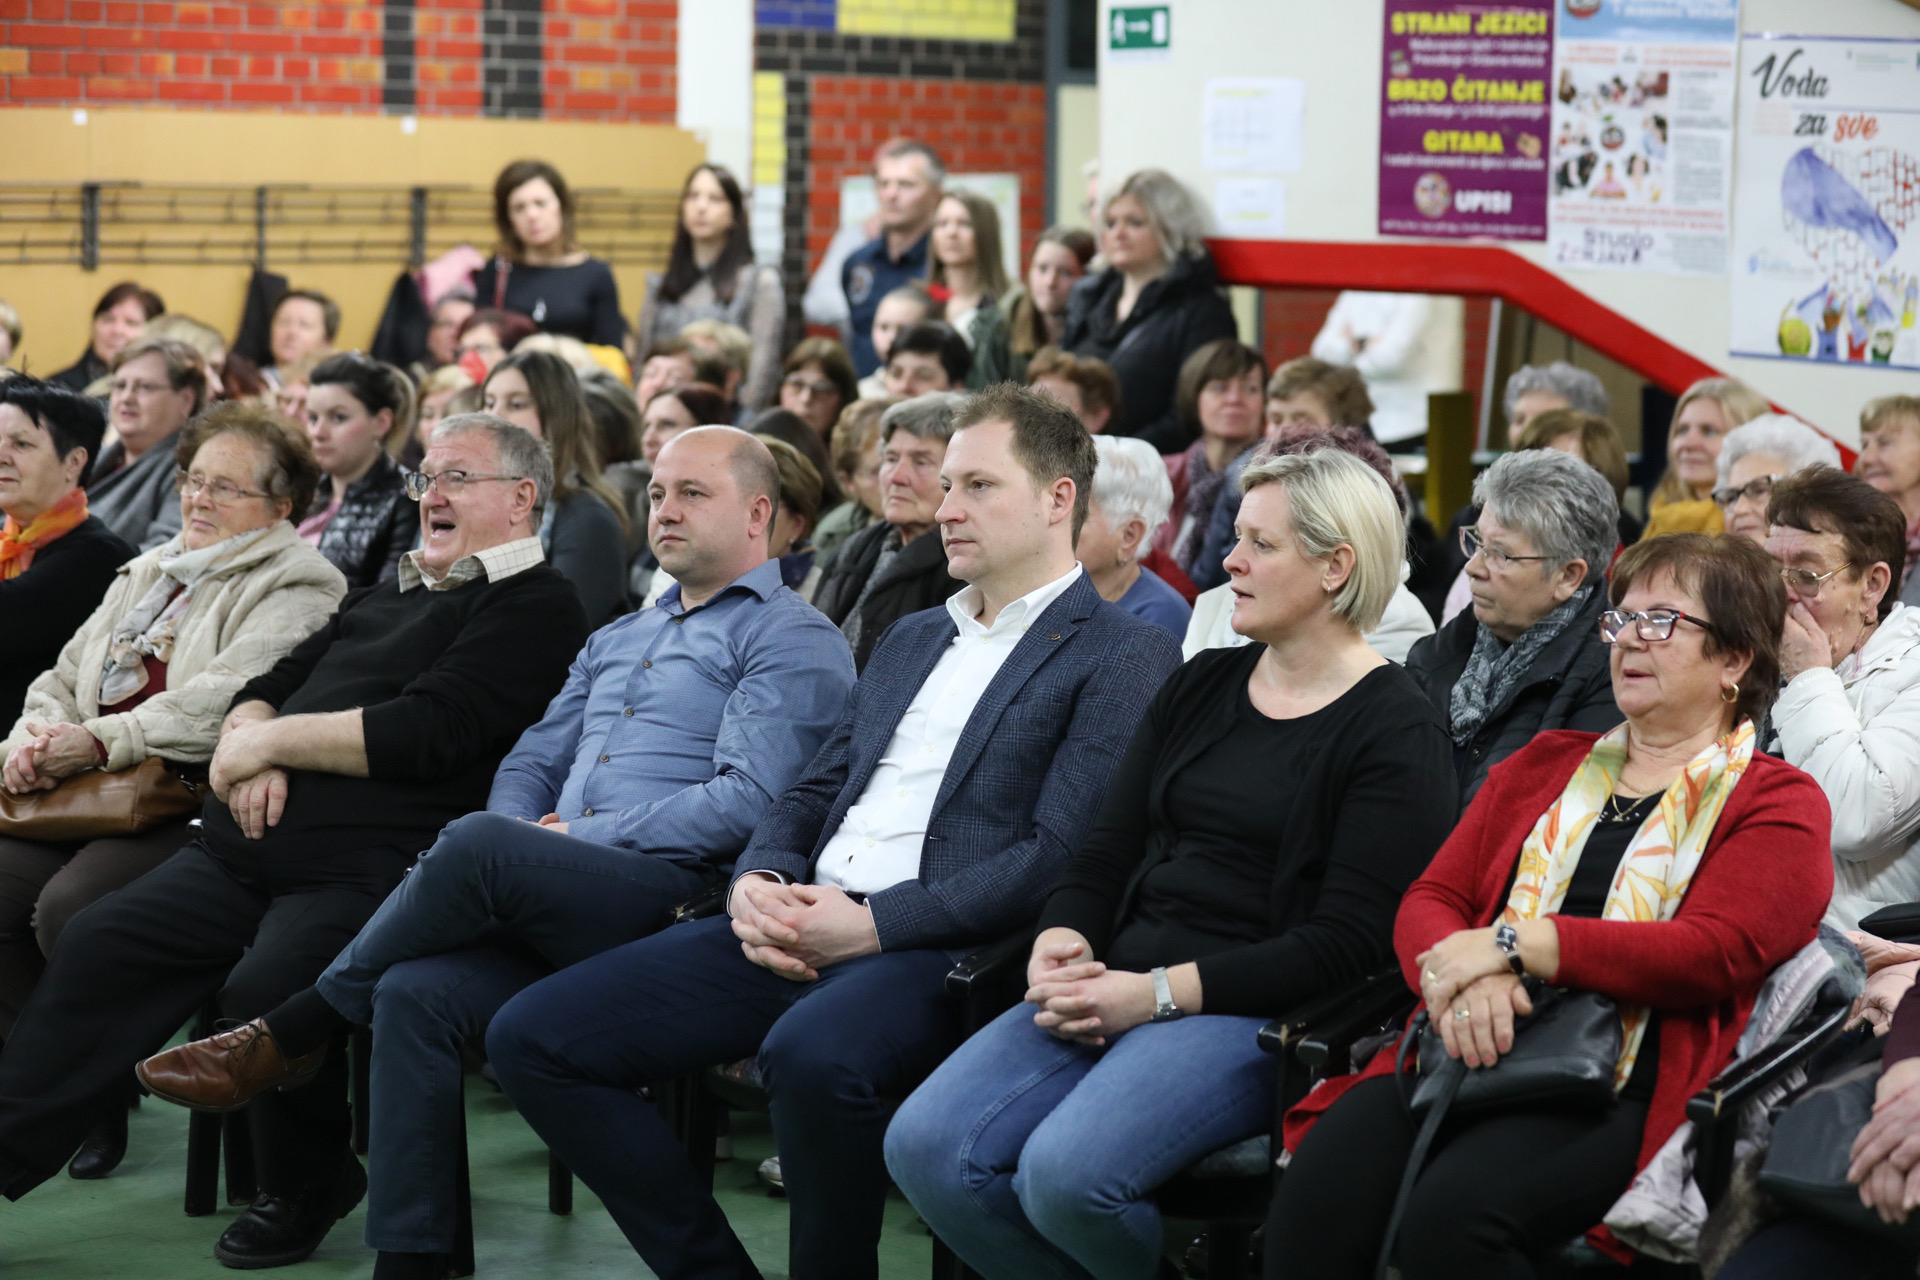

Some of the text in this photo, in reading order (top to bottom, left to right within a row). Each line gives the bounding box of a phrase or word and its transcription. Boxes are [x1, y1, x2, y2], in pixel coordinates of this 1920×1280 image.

[1391, 12, 1547, 35] STRANI JEZICI
[1752, 48, 1829, 99] Voda
[1387, 73, 1545, 103] BRZO ČITANJE
[1794, 112, 1878, 143] za sve
[1423, 130, 1504, 153] GITARA
[1454, 189, 1512, 214] UPISI
